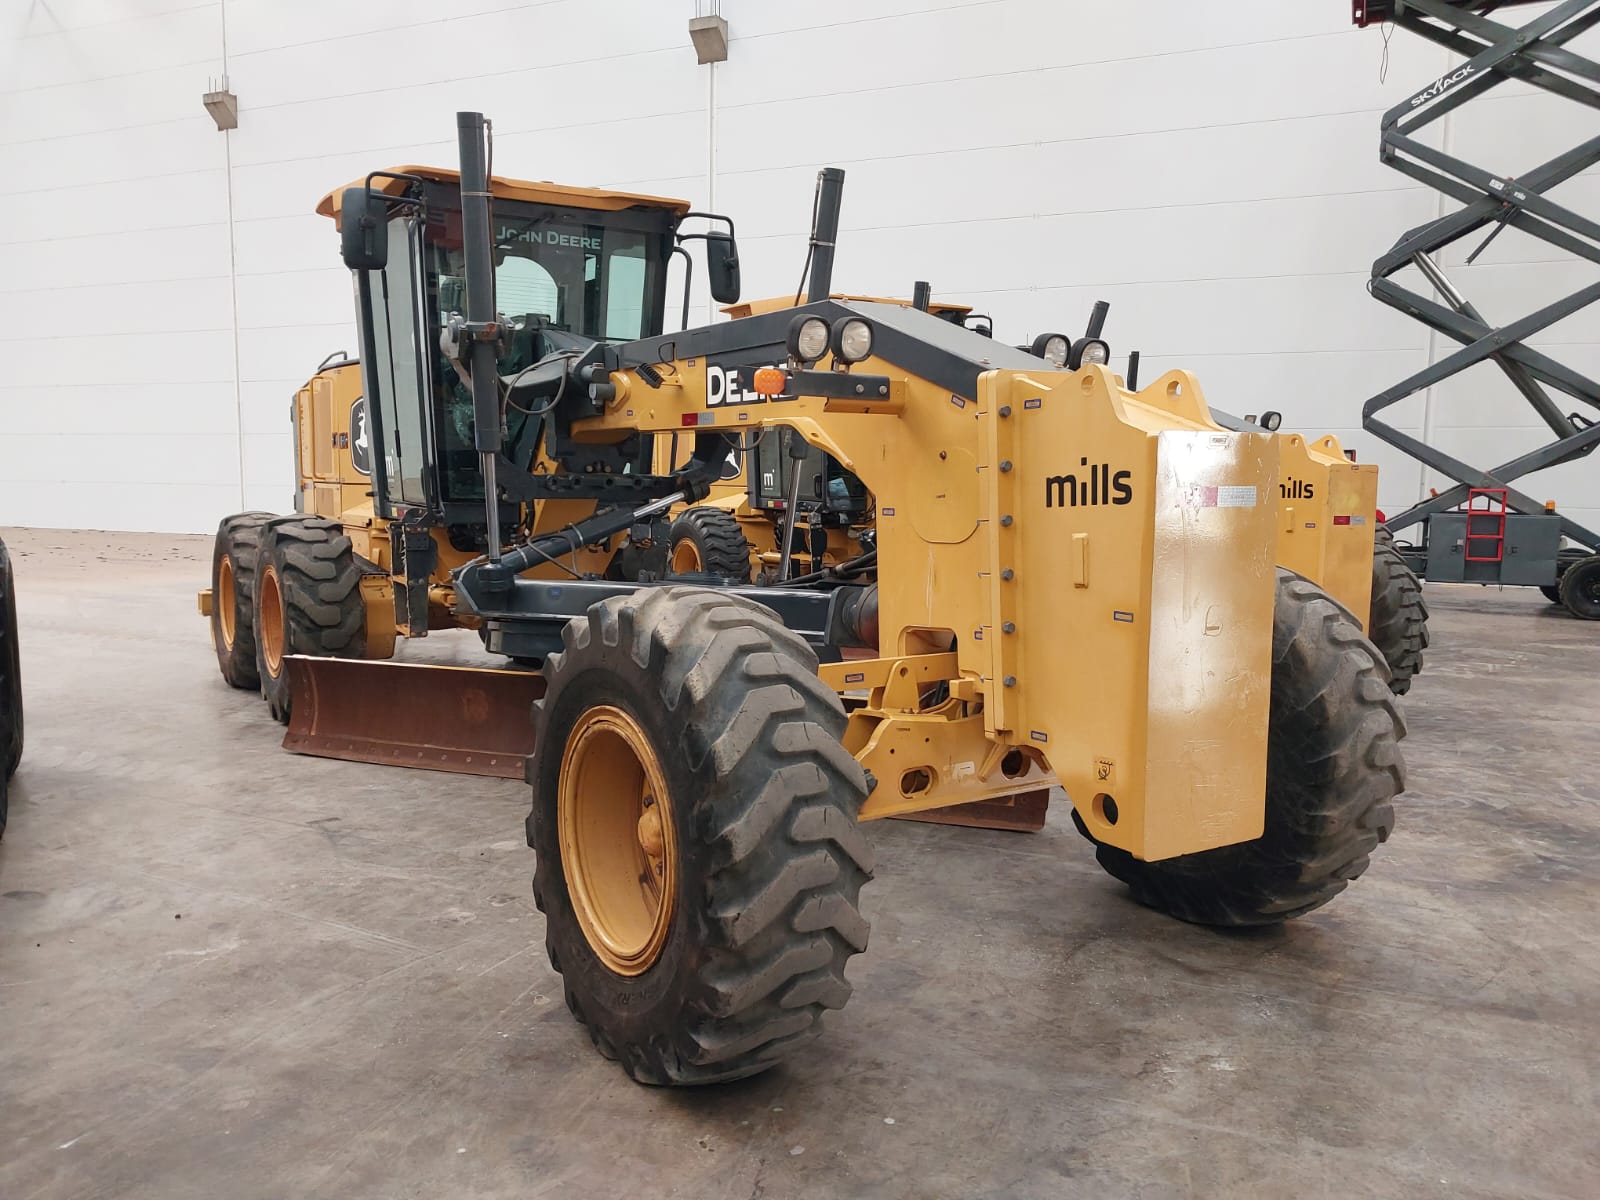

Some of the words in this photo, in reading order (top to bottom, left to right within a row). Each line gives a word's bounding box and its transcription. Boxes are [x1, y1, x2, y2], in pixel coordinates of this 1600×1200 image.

[1411, 64, 1475, 107] SKYJACK
[496, 226, 542, 243] JOHN
[546, 230, 601, 249] DEERE
[1046, 457, 1132, 508] mills
